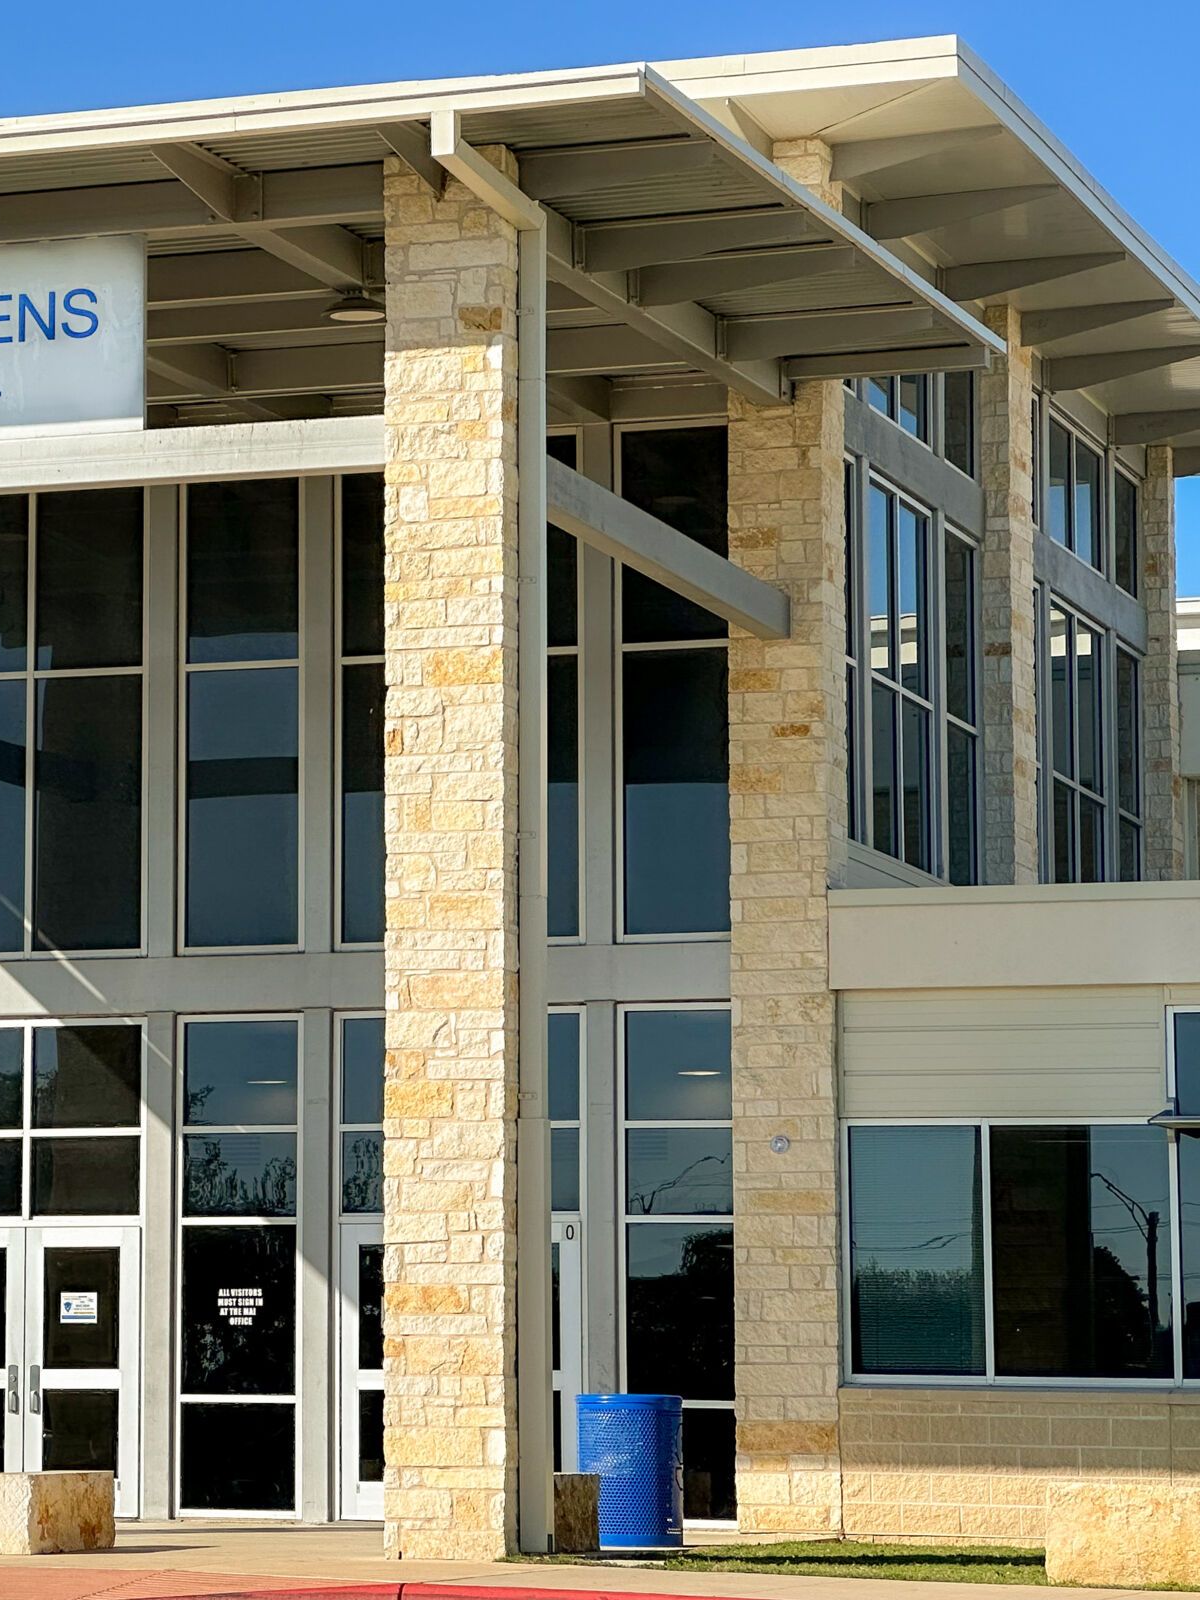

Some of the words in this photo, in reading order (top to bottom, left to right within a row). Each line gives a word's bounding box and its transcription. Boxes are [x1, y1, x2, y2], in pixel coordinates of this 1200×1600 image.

[218, 1288, 230, 1297] ALL
[230, 1288, 262, 1297] VISITORS
[218, 1298, 237, 1306] MUST
[237, 1298, 254, 1306] SIGN
[255, 1298, 264, 1306] IN
[219, 1307, 228, 1316] AT
[229, 1307, 242, 1316] THE
[229, 1317, 253, 1325] OFFICE
